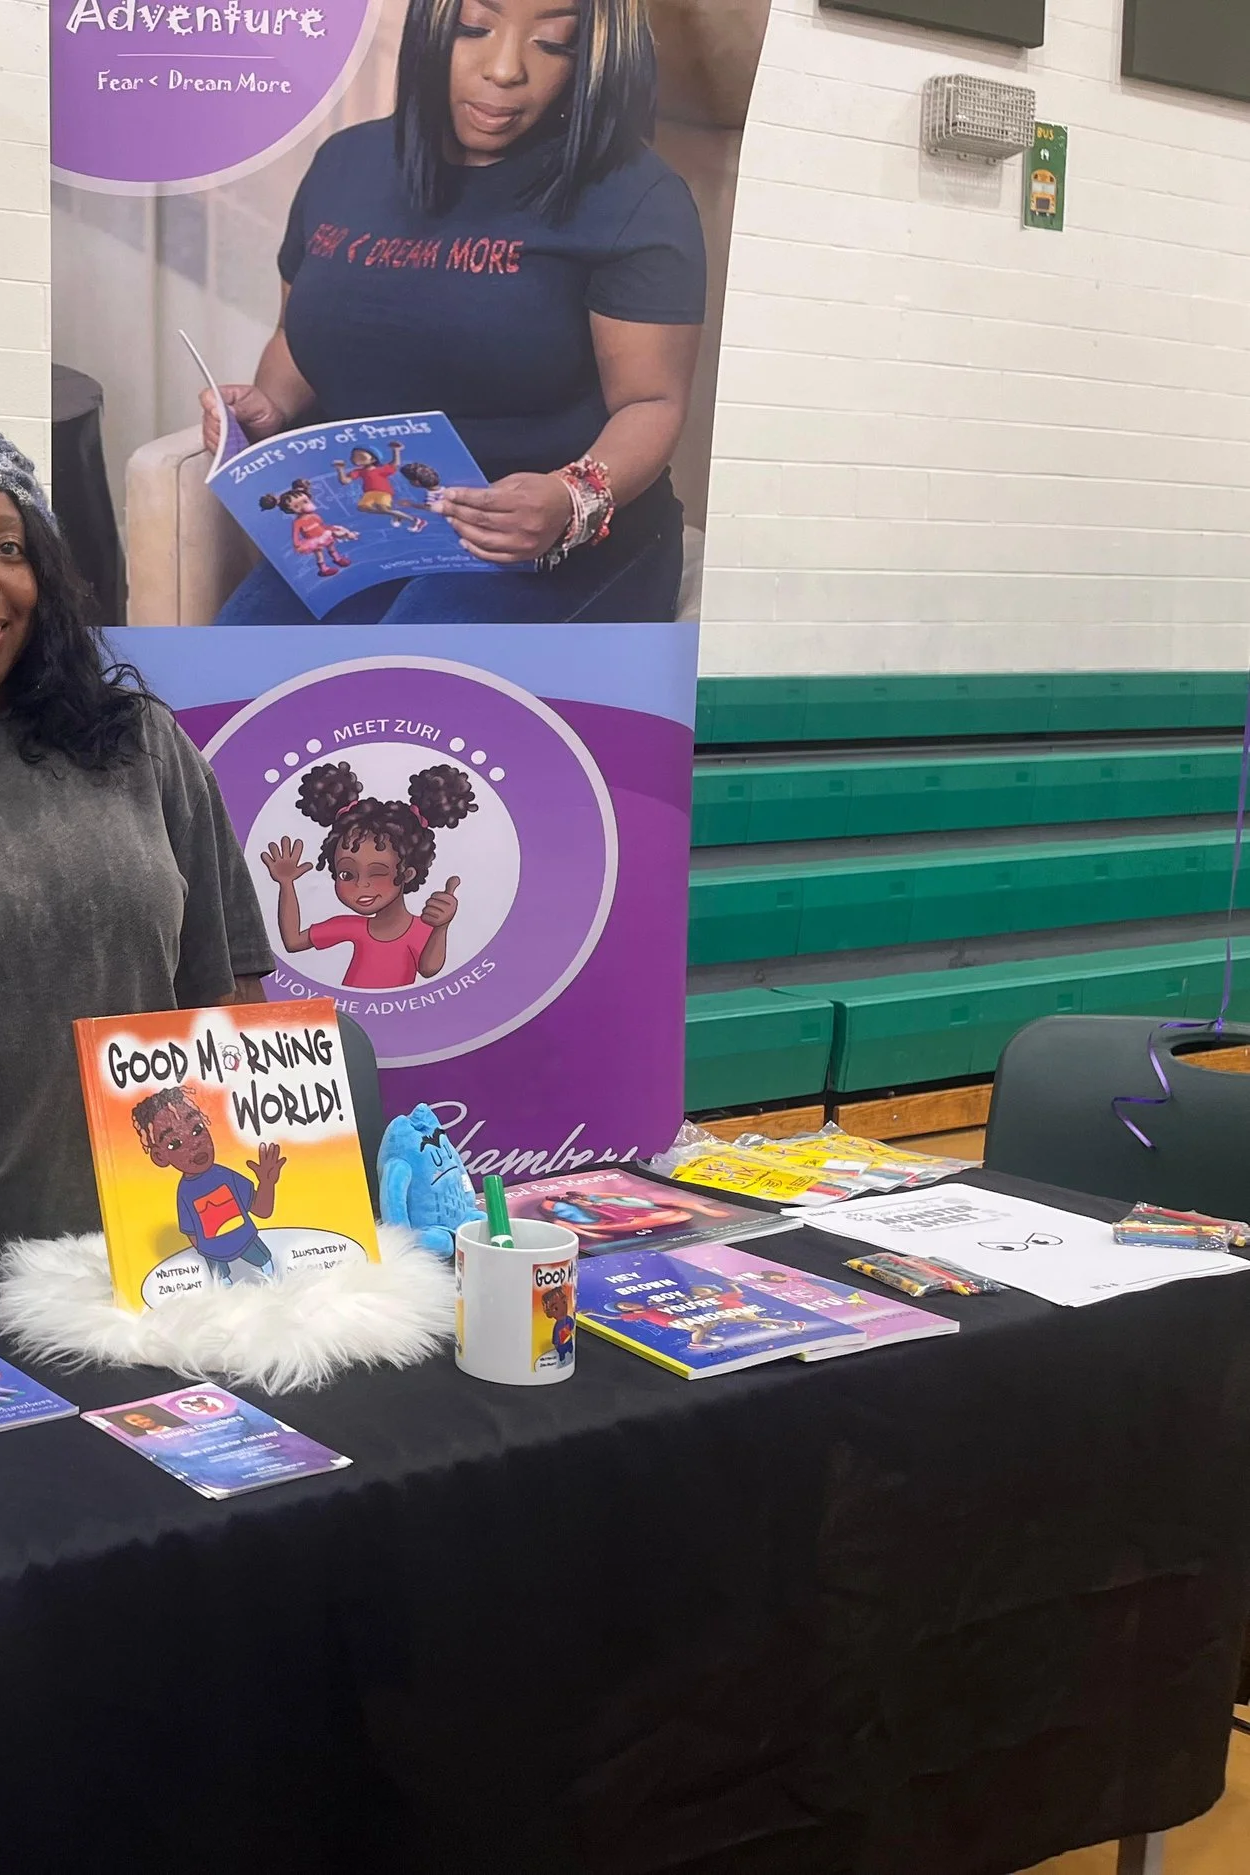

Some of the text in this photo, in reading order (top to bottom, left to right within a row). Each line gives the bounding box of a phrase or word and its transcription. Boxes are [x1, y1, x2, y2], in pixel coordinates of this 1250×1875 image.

[66, 0, 327, 38] Adventure
[97, 69, 143, 91] Fear
[169, 70, 232, 92] Dream
[235, 72, 292, 93] More
[1036, 127, 1054, 141] BUS
[365, 237, 442, 269] DREAM
[446, 237, 524, 274] MORE
[288, 435, 327, 455] Day
[334, 429, 358, 444] of
[333, 719, 442, 743] MEET ZURI
[268, 968, 319, 1001] NJOY
[365, 958, 496, 1016] ADVENTURES
[108, 1042, 188, 1089] GOOD
[232, 1079, 344, 1136] WORLD!
[536, 1268, 566, 1288] GOOD
[605, 1271, 641, 1284] HEY
[614, 1278, 678, 1296] BROWN
[648, 1290, 686, 1303] BOY
[657, 1297, 724, 1315] YOU'RE
[668, 1303, 768, 1331] HANDSOME
